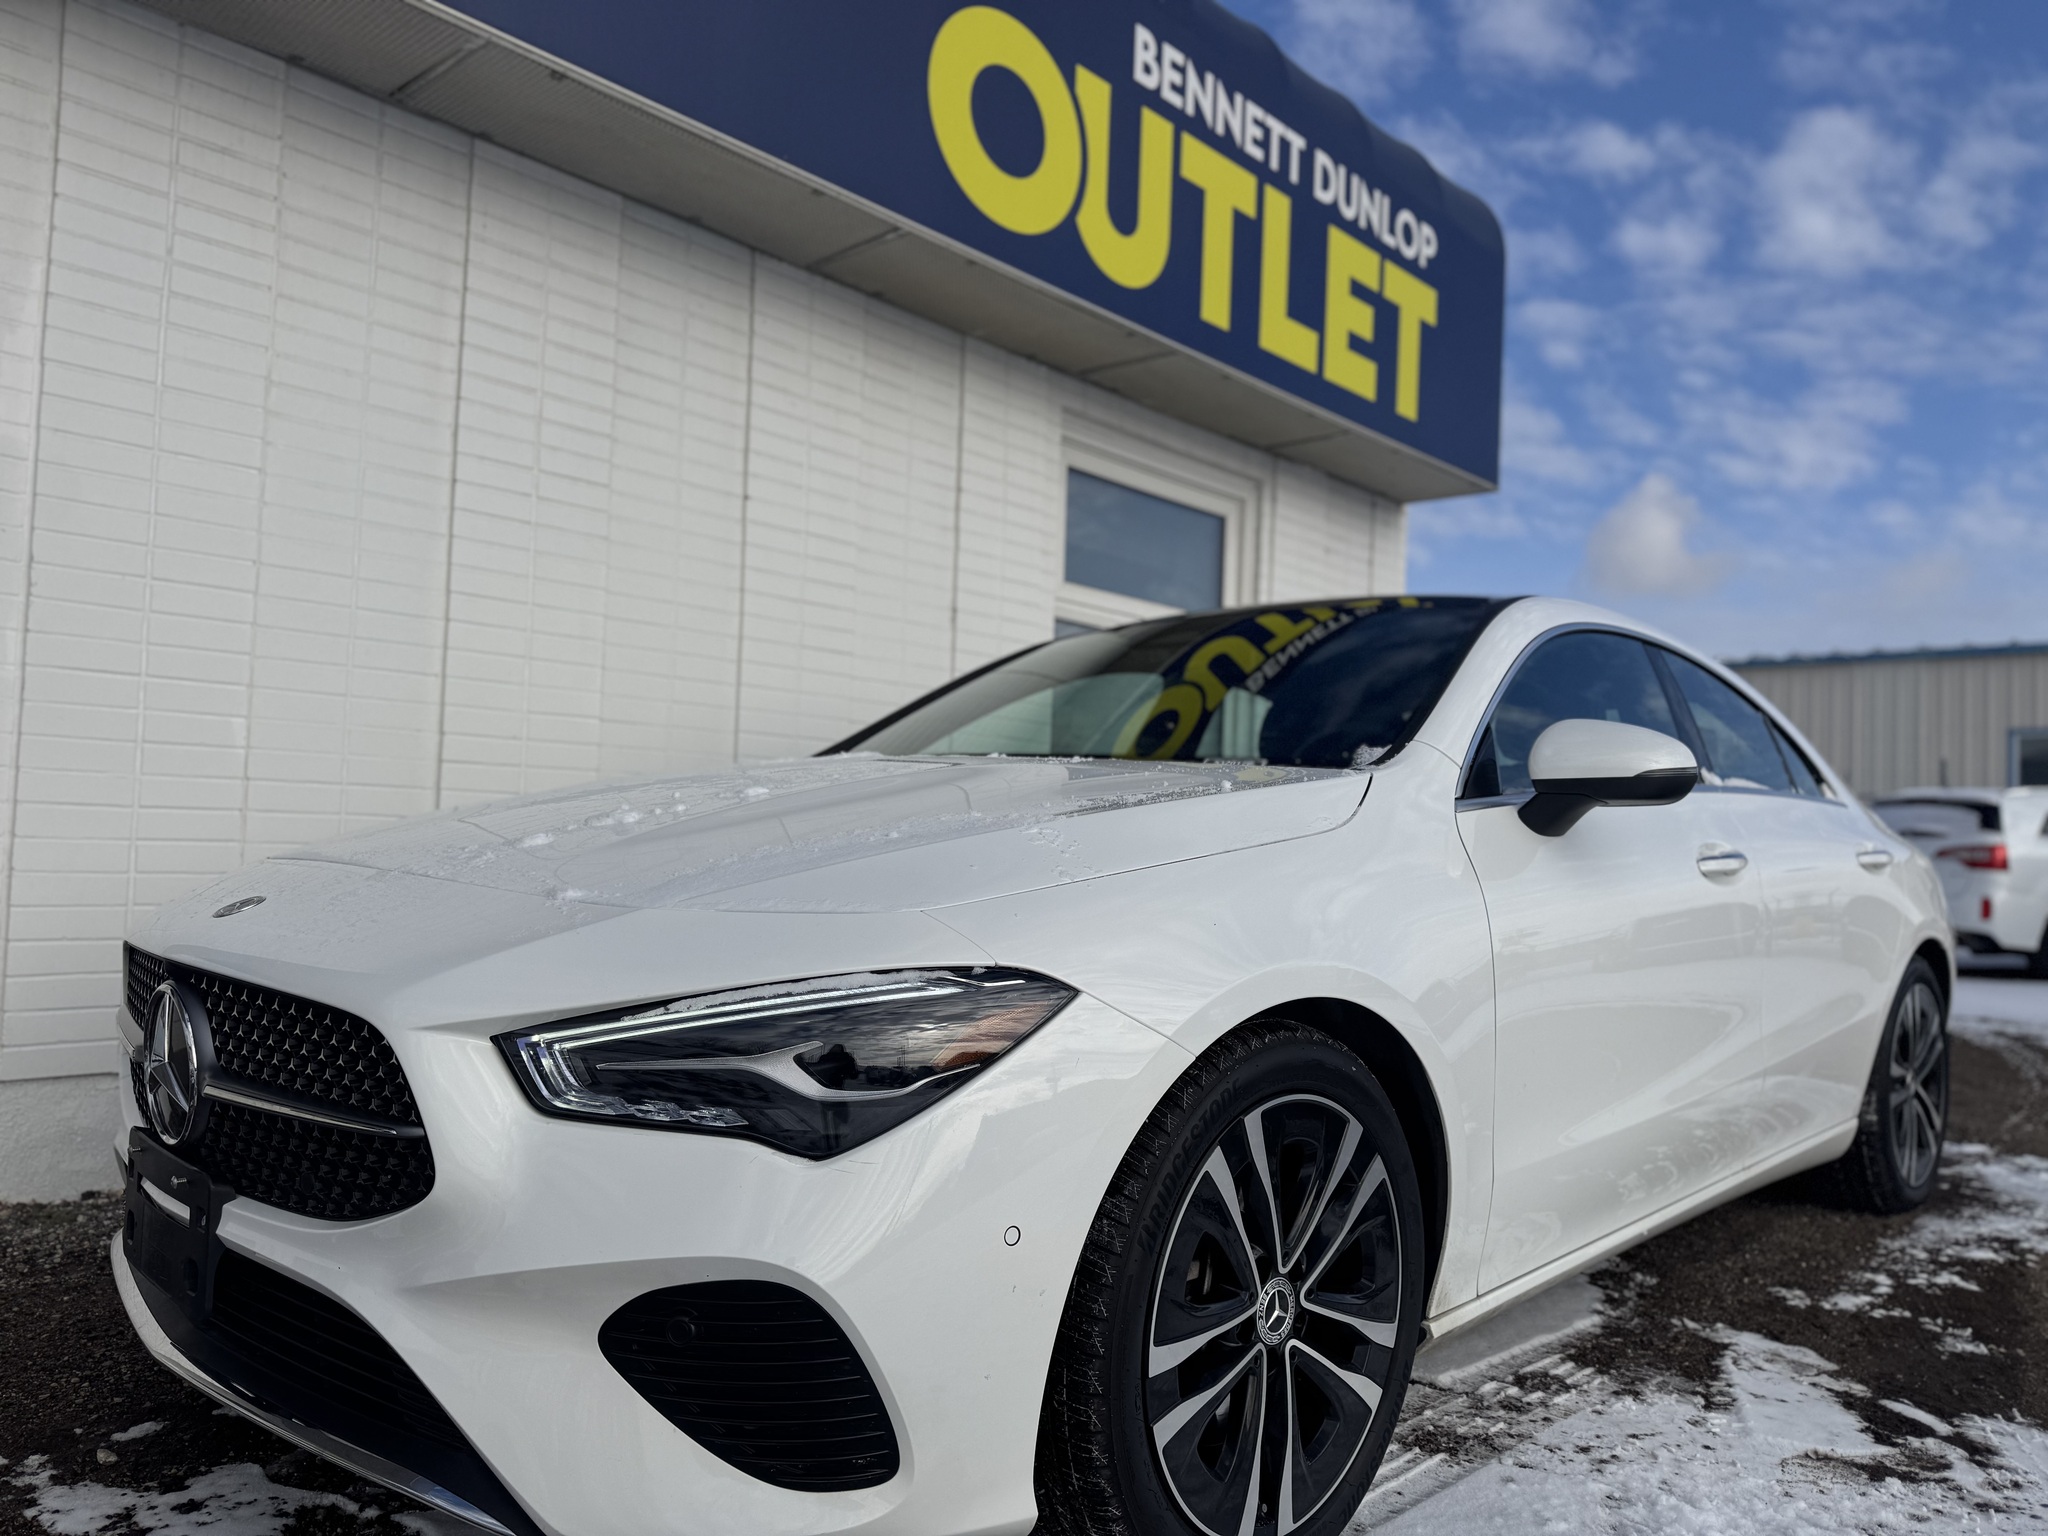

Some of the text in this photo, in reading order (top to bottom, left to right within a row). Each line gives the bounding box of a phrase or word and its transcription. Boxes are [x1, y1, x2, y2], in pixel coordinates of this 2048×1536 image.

[927, 5, 1438, 423] OUTLET
[1133, 22, 1438, 269] BENNETT DUNLOP
[1137, 1077, 1243, 1258] BRIDGESTONE
